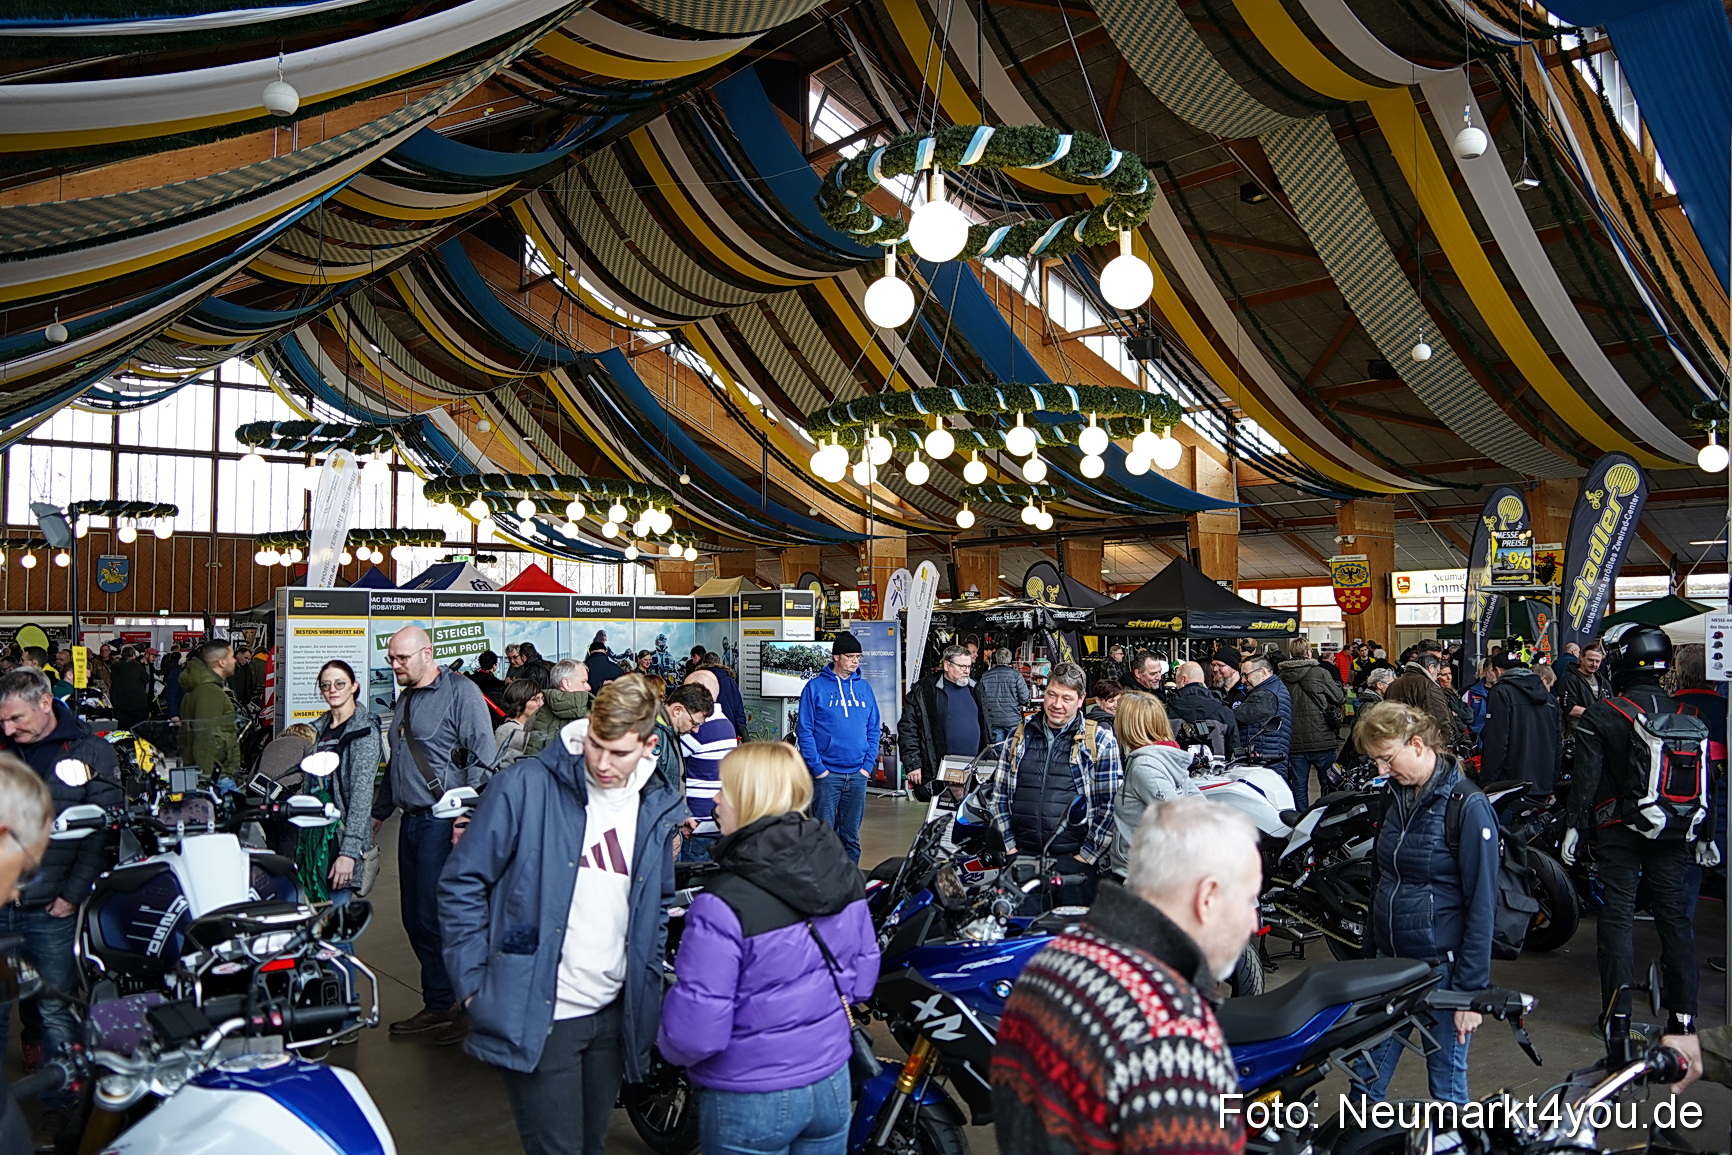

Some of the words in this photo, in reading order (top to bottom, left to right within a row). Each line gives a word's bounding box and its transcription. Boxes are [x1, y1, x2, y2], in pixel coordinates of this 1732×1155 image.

[1495, 530, 1520, 540] MESSE
[1501, 539, 1530, 548] PREISE!
[1566, 485, 1624, 632] stadler
[1581, 582, 1608, 635] Deutschlands
[1602, 551, 1619, 583] größtes
[1611, 493, 1641, 553] Zweirad-Center
[1479, 593, 1500, 638] Deutschlands
[1124, 618, 1174, 630] stadler
[1247, 619, 1289, 630] stadler
[436, 625, 482, 640] STEIGER
[435, 645, 457, 656] ZUM
[459, 641, 487, 653] PROFI
